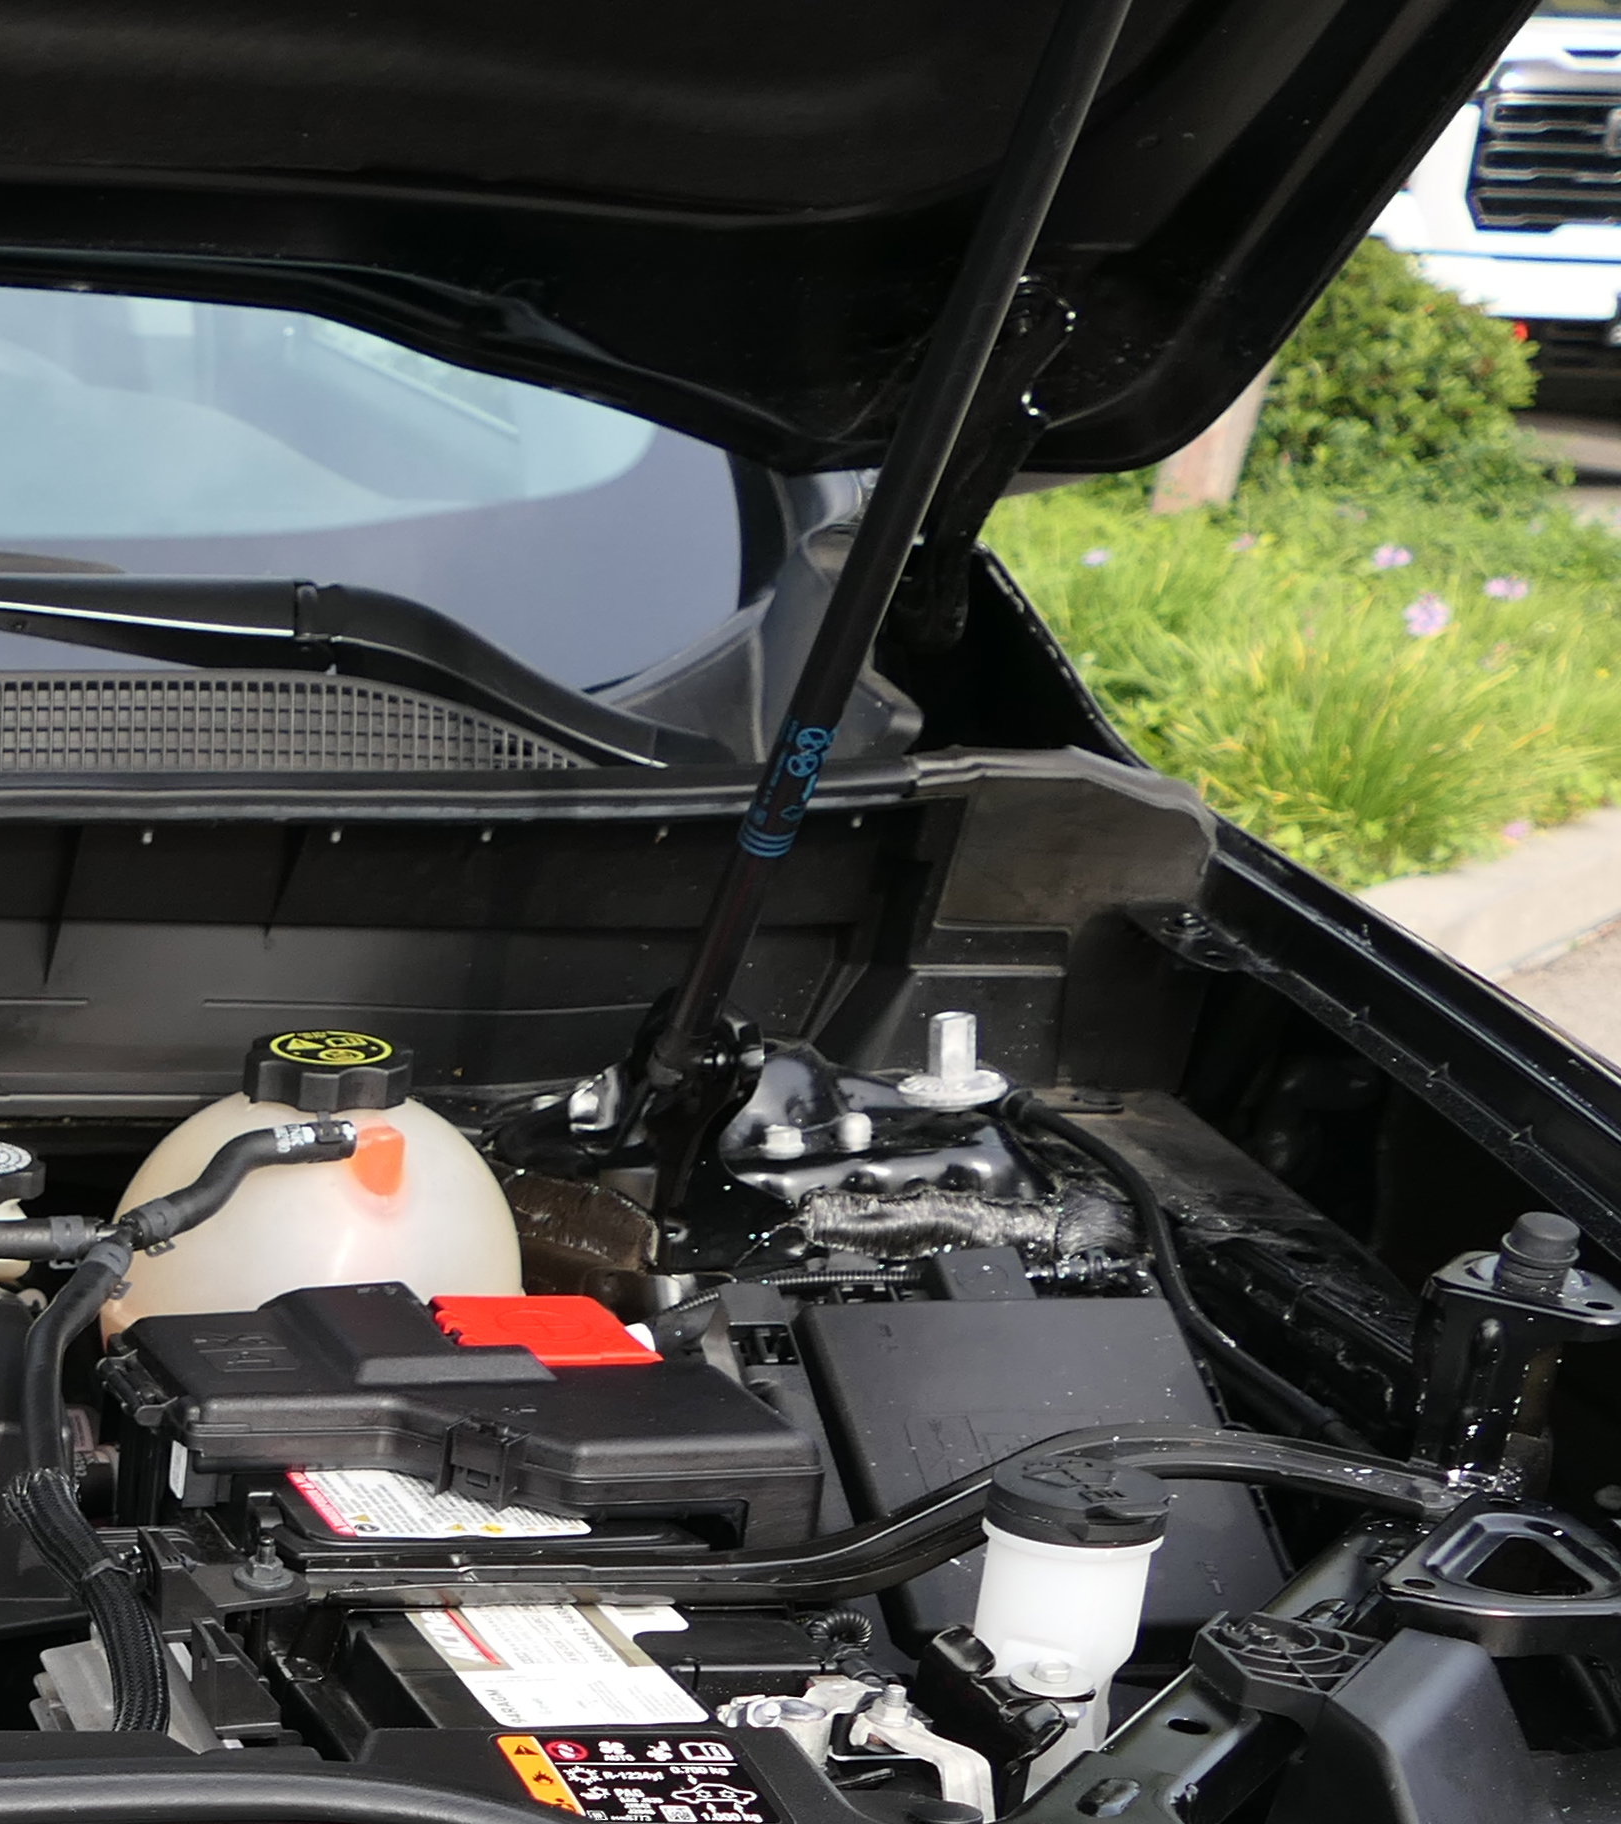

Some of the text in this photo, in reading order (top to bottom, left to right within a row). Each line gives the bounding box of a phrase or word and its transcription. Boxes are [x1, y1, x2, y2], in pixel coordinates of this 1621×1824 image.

[419, 1611, 485, 1662] ACDe
[485, 1688, 527, 1723] 94RAGM
[602, 1771, 665, 1781] R-1234yf
[708, 1766, 729, 1776] kg
[613, 1788, 645, 1798] PAG
[701, 1812, 763, 1823] 1.000 kg
